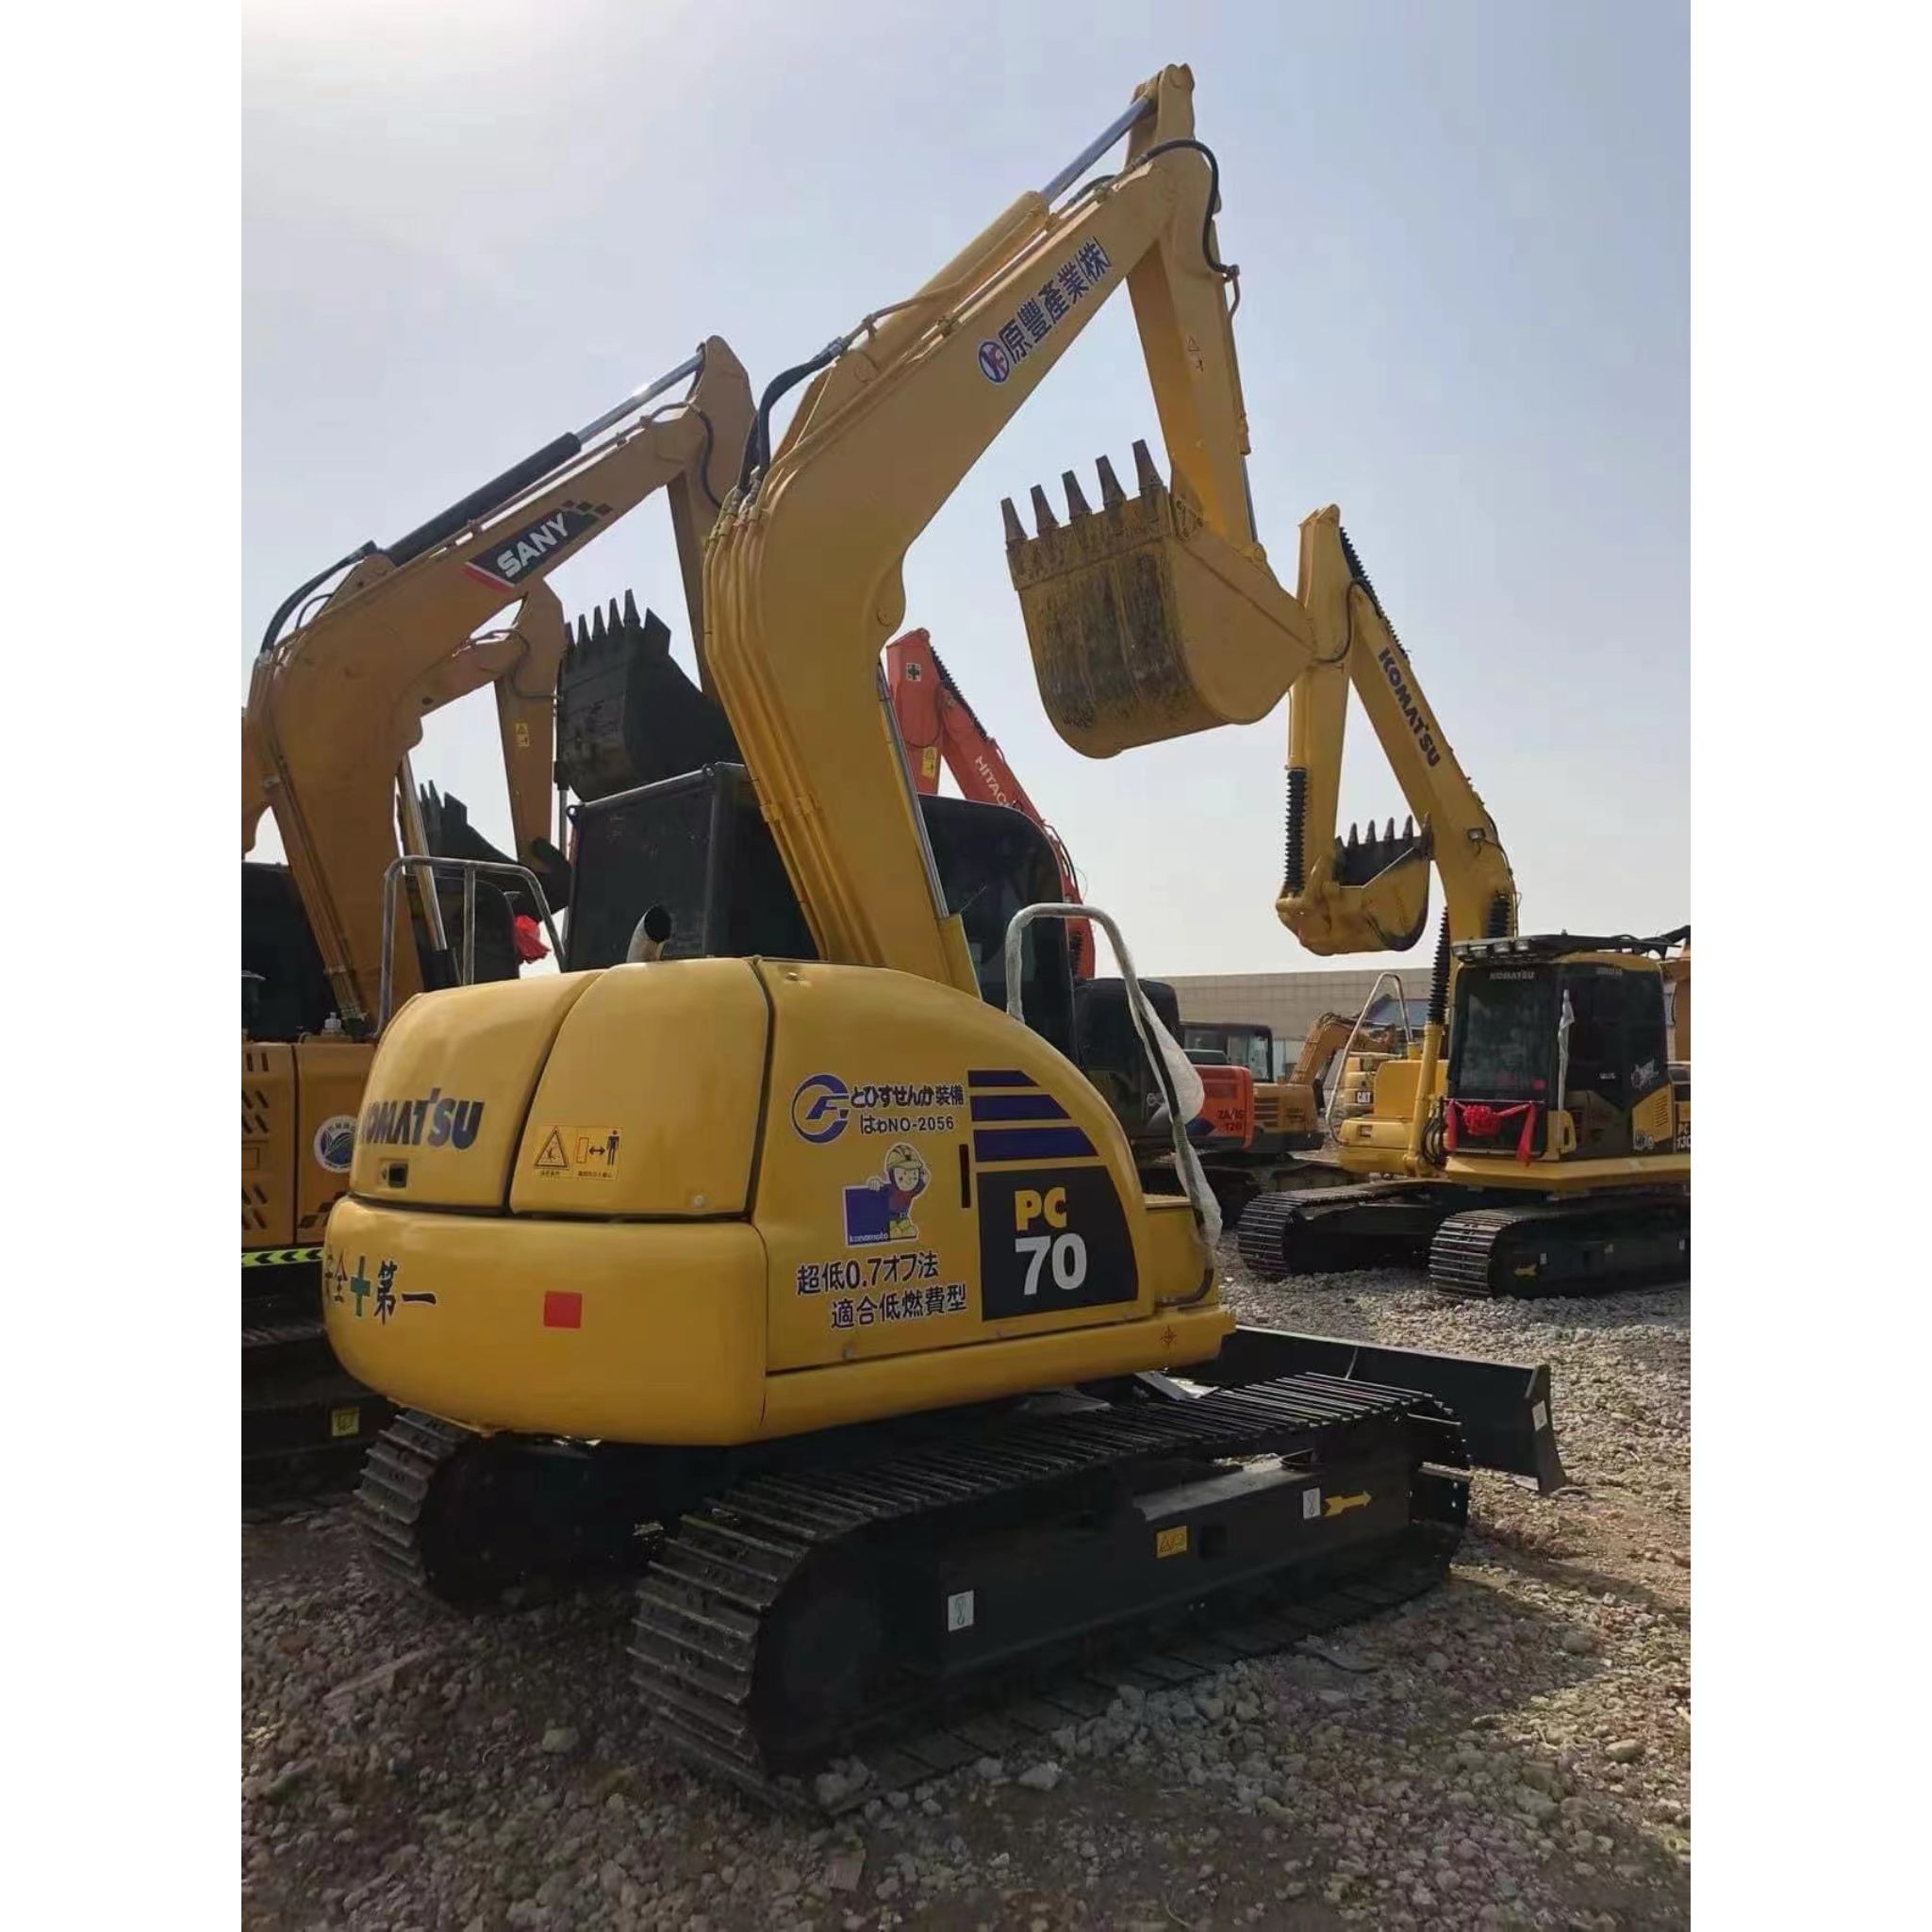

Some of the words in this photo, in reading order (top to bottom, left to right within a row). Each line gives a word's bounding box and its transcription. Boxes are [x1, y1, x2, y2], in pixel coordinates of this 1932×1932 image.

[497, 513, 568, 578] SANY
[1379, 647, 1441, 768] KOMATSU
[975, 755, 1010, 807] HITAC
[364, 1087, 486, 1150] OMATSU
[1015, 1188, 1066, 1231] PC
[1016, 1233, 1086, 1296] 70
